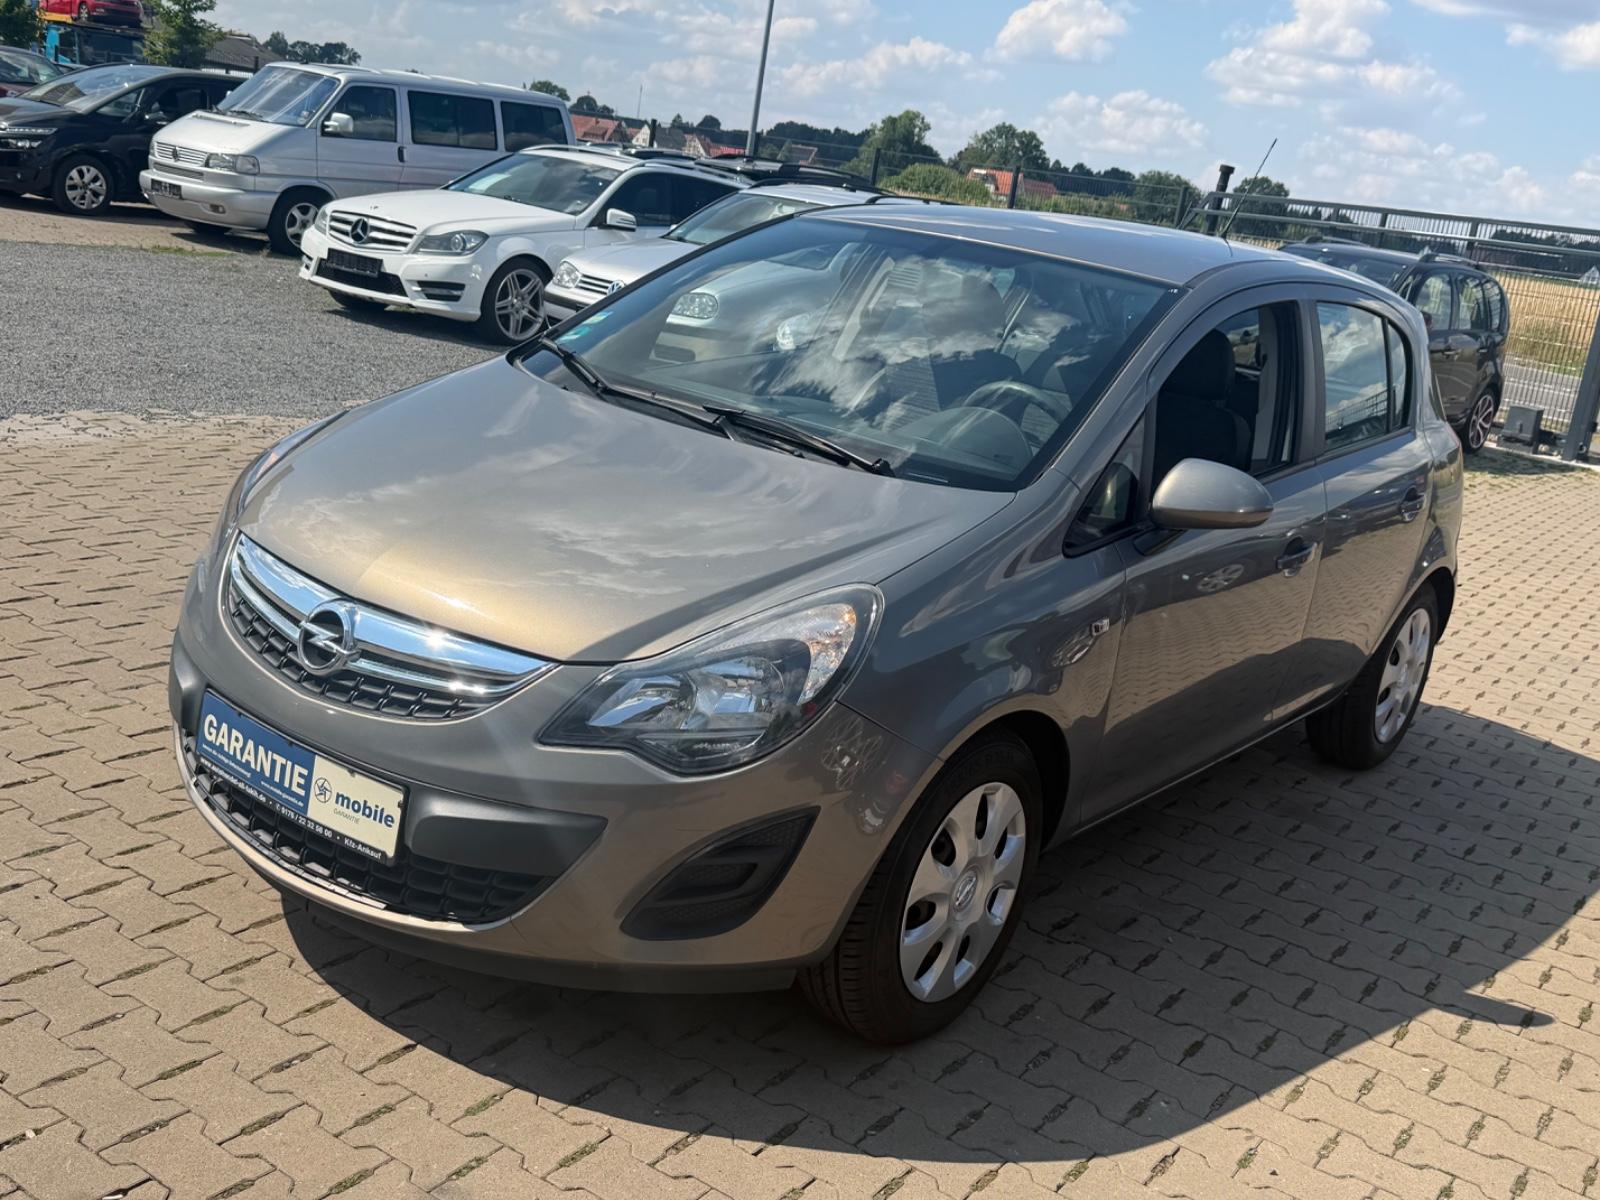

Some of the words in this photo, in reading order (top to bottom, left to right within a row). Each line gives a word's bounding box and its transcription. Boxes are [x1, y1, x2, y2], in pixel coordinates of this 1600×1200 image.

[203, 713, 308, 796] GARANTIE
[335, 791, 395, 828] mobile
[344, 838, 382, 859] Kfz-Ankauf
